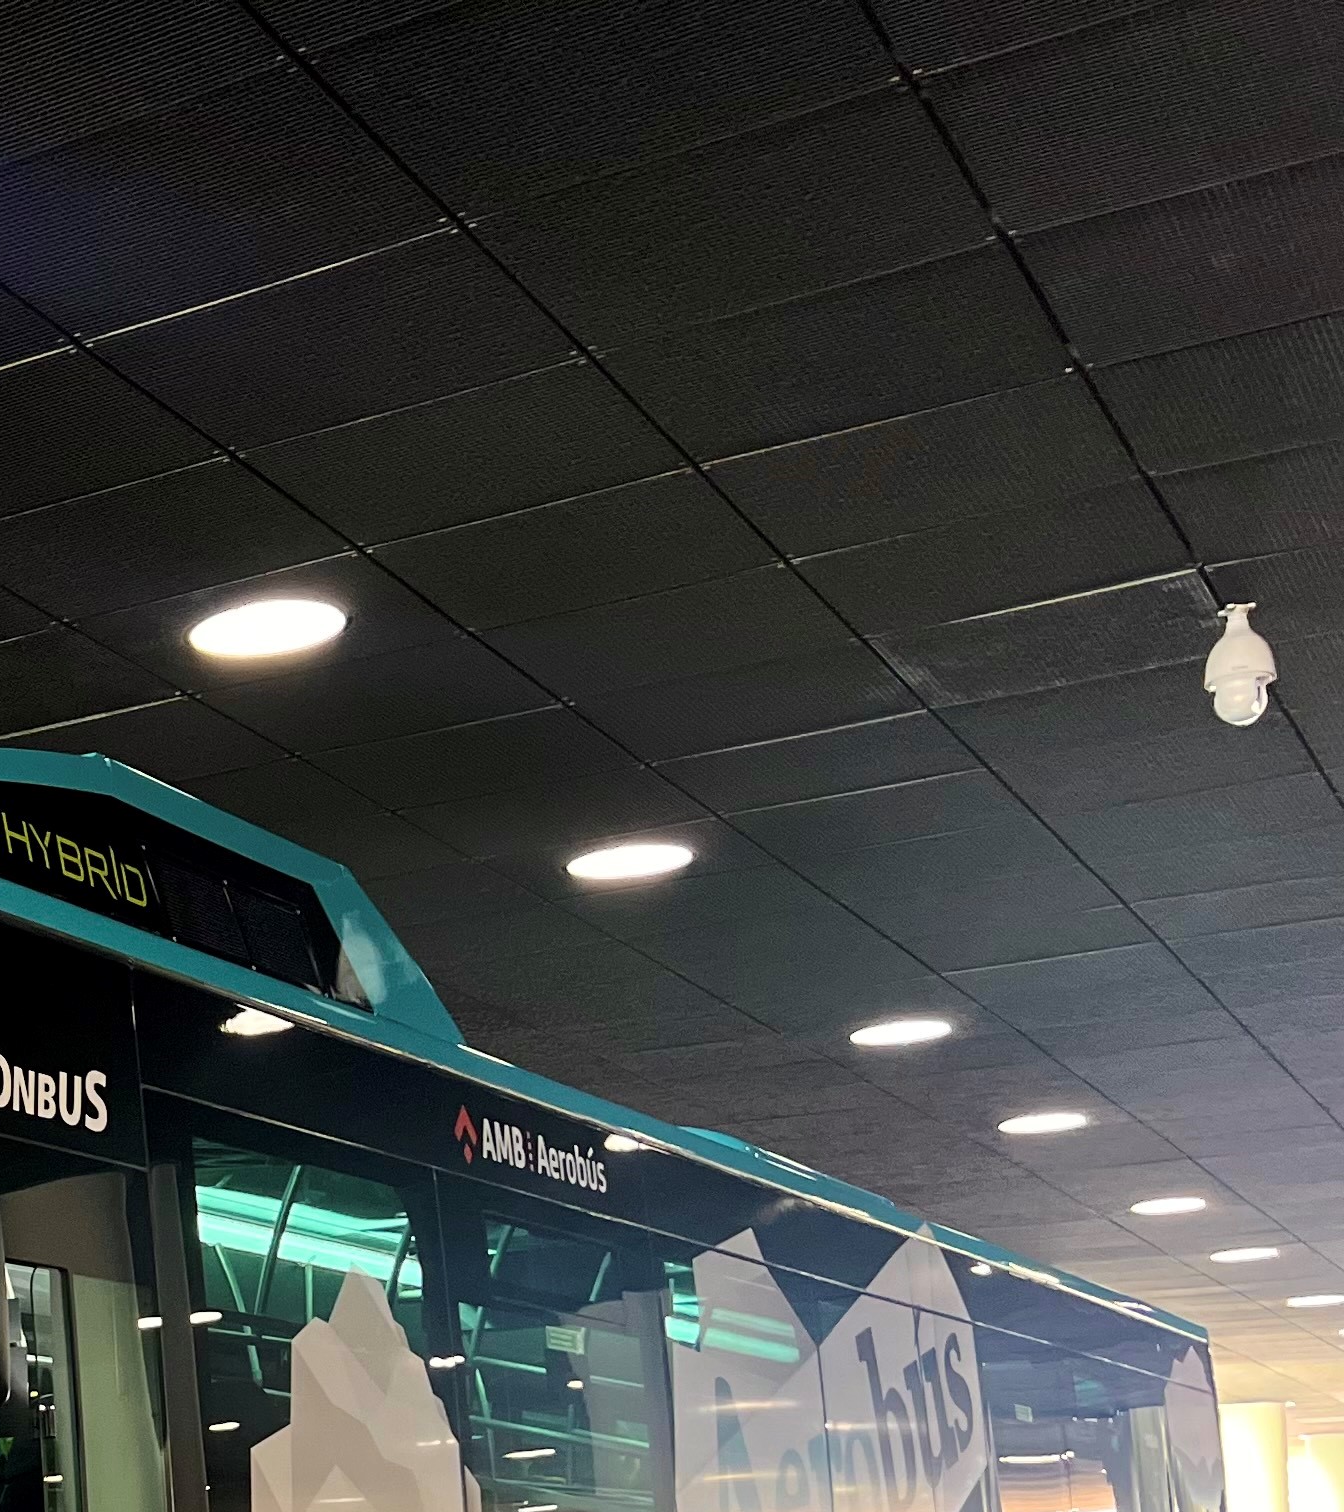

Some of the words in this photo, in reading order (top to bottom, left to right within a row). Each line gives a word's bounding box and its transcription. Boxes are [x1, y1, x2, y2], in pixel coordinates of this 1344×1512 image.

[0, 812, 147, 908] HYBRID
[482, 1117, 527, 1170] AMB
[537, 1134, 607, 1194] Aerobús
